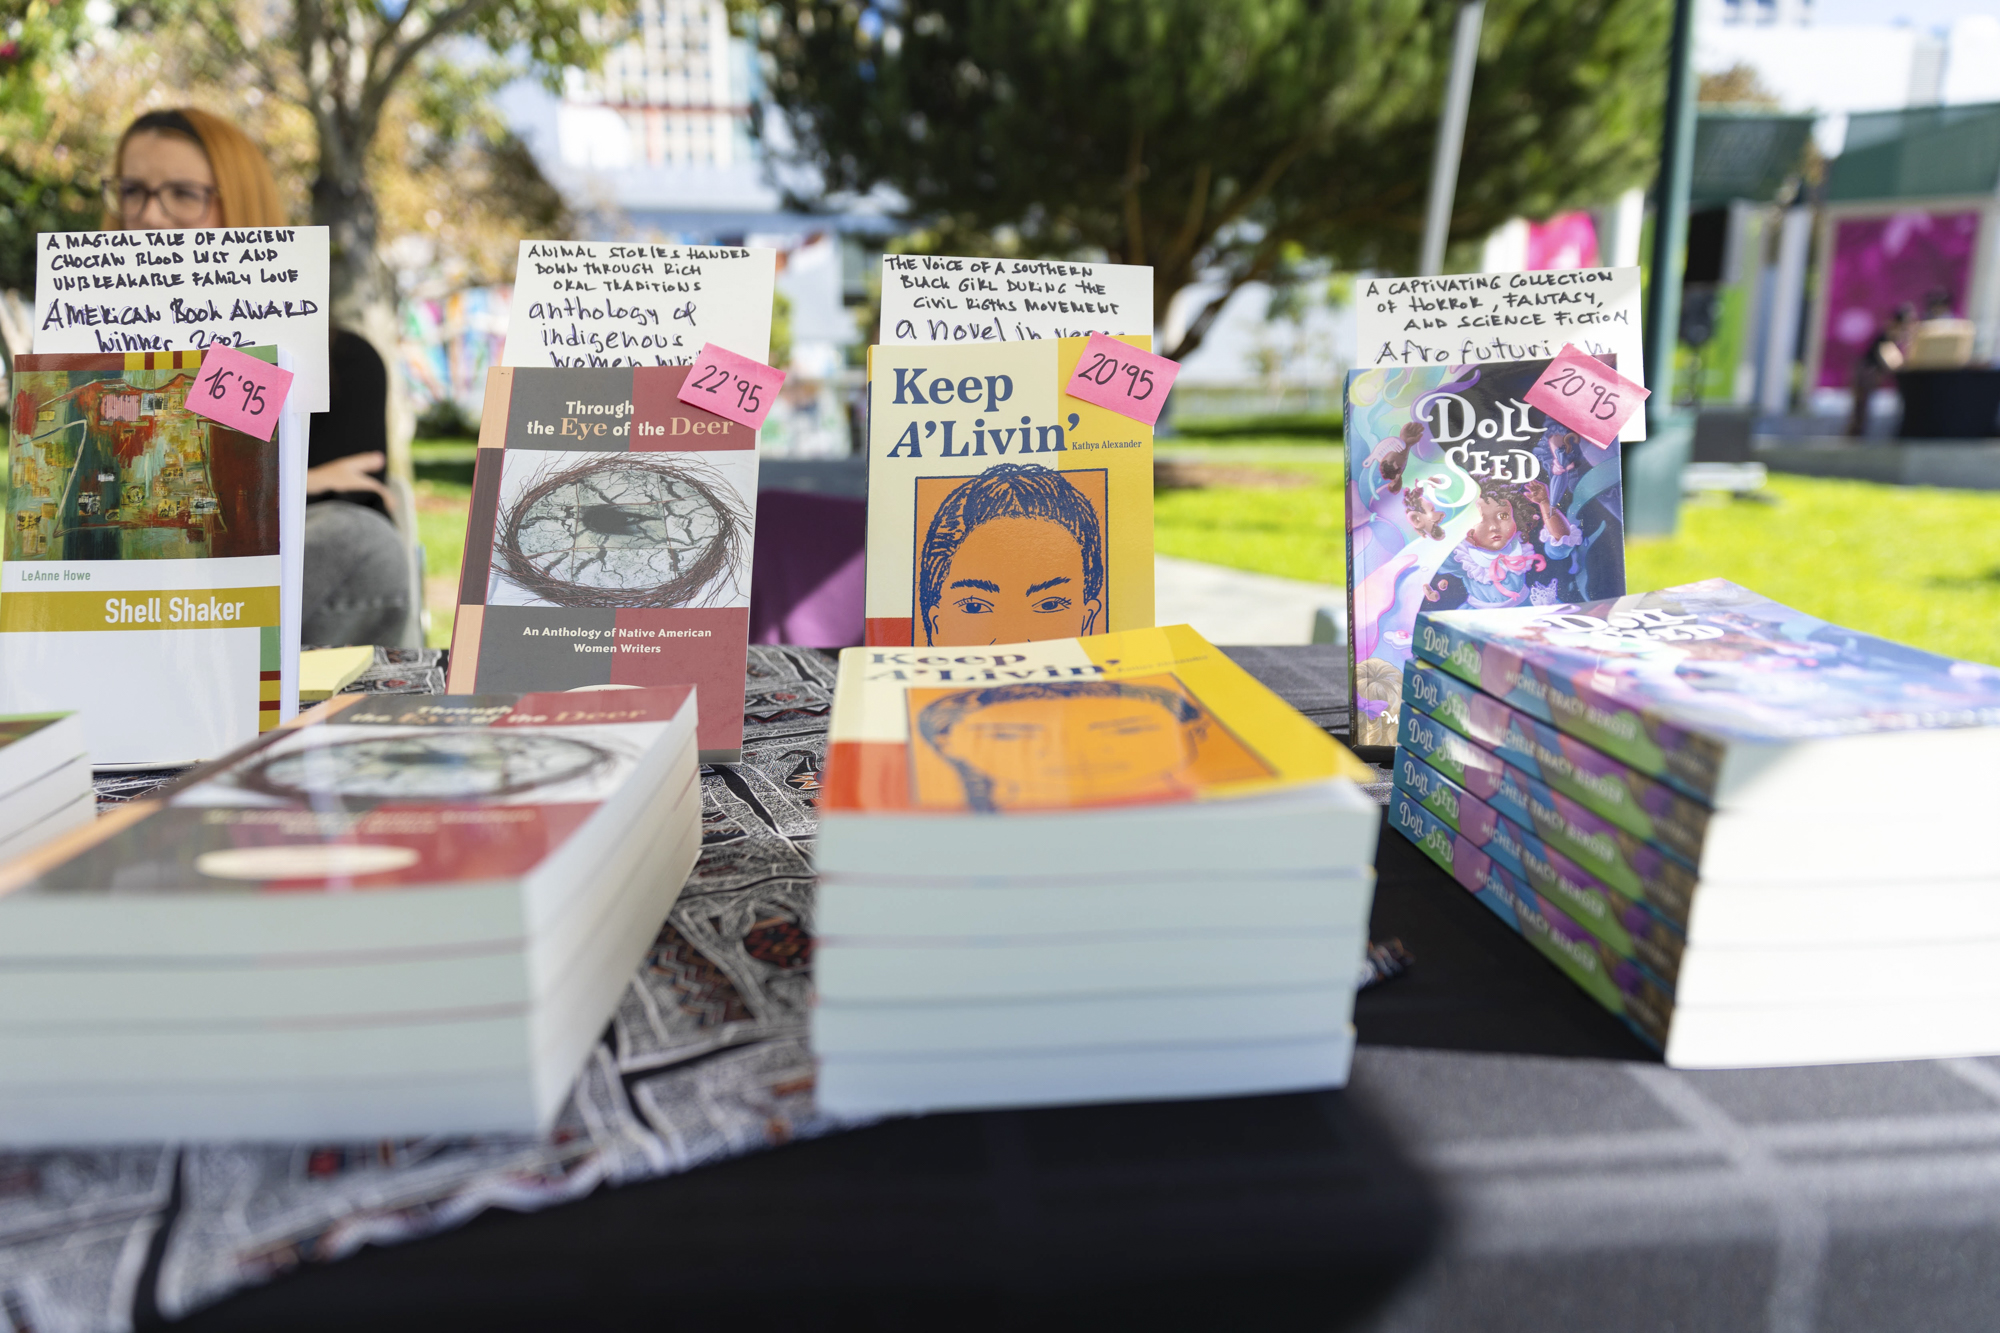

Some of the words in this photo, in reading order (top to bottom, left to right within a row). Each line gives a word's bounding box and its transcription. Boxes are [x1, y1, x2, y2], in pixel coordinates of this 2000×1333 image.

[47, 234, 60, 250] A
[145, 232, 185, 246] TALE
[195, 231, 215, 245] OF
[136, 251, 184, 266] BLOOD
[193, 250, 229, 263] LUST
[239, 248, 278, 263] AND
[528, 244, 596, 258] ANIMAL
[609, 246, 680, 258] STORIES
[687, 247, 750, 260] HANDED
[535, 262, 577, 274] DOWN
[885, 255, 918, 270] THE
[970, 261, 991, 273] OF
[994, 261, 1005, 275] A
[53, 273, 185, 291] UNBREAKABLE
[260, 268, 298, 283] LOVE
[553, 279, 597, 291] ORAL
[1366, 281, 1379, 297] A
[528, 296, 659, 326] anthology
[673, 301, 697, 326] of
[1024, 298, 1119, 315] MOVEMENT
[1377, 299, 1397, 313] OF
[895, 319, 917, 339] a
[927, 317, 1006, 342] novel
[1015, 322, 1042, 341] in
[1404, 317, 1447, 331] AND
[541, 323, 683, 353] indigenous
[892, 368, 1014, 412] Keep
[565, 400, 634, 418] Through
[527, 421, 555, 435] the
[559, 417, 608, 441] Eye
[612, 421, 632, 436] of
[638, 421, 665, 436] the
[669, 417, 733, 436] Deer
[887, 412, 1080, 458] A'Livin'
[1072, 441, 1100, 451] Kathya
[1101, 440, 1142, 449] Alexander
[21, 570, 60, 582] LeAnne
[63, 570, 91, 581] Howe
[105, 597, 161, 623] Shell
[168, 596, 245, 622] Shaker
[523, 626, 539, 637] An
[542, 626, 601, 640] Anthology
[603, 627, 617, 638] of
[618, 628, 655, 638] Native
[657, 628, 712, 638] American
[573, 643, 617, 653] Women
[620, 643, 661, 654] Writers
[872, 652, 1027, 666] Keep
